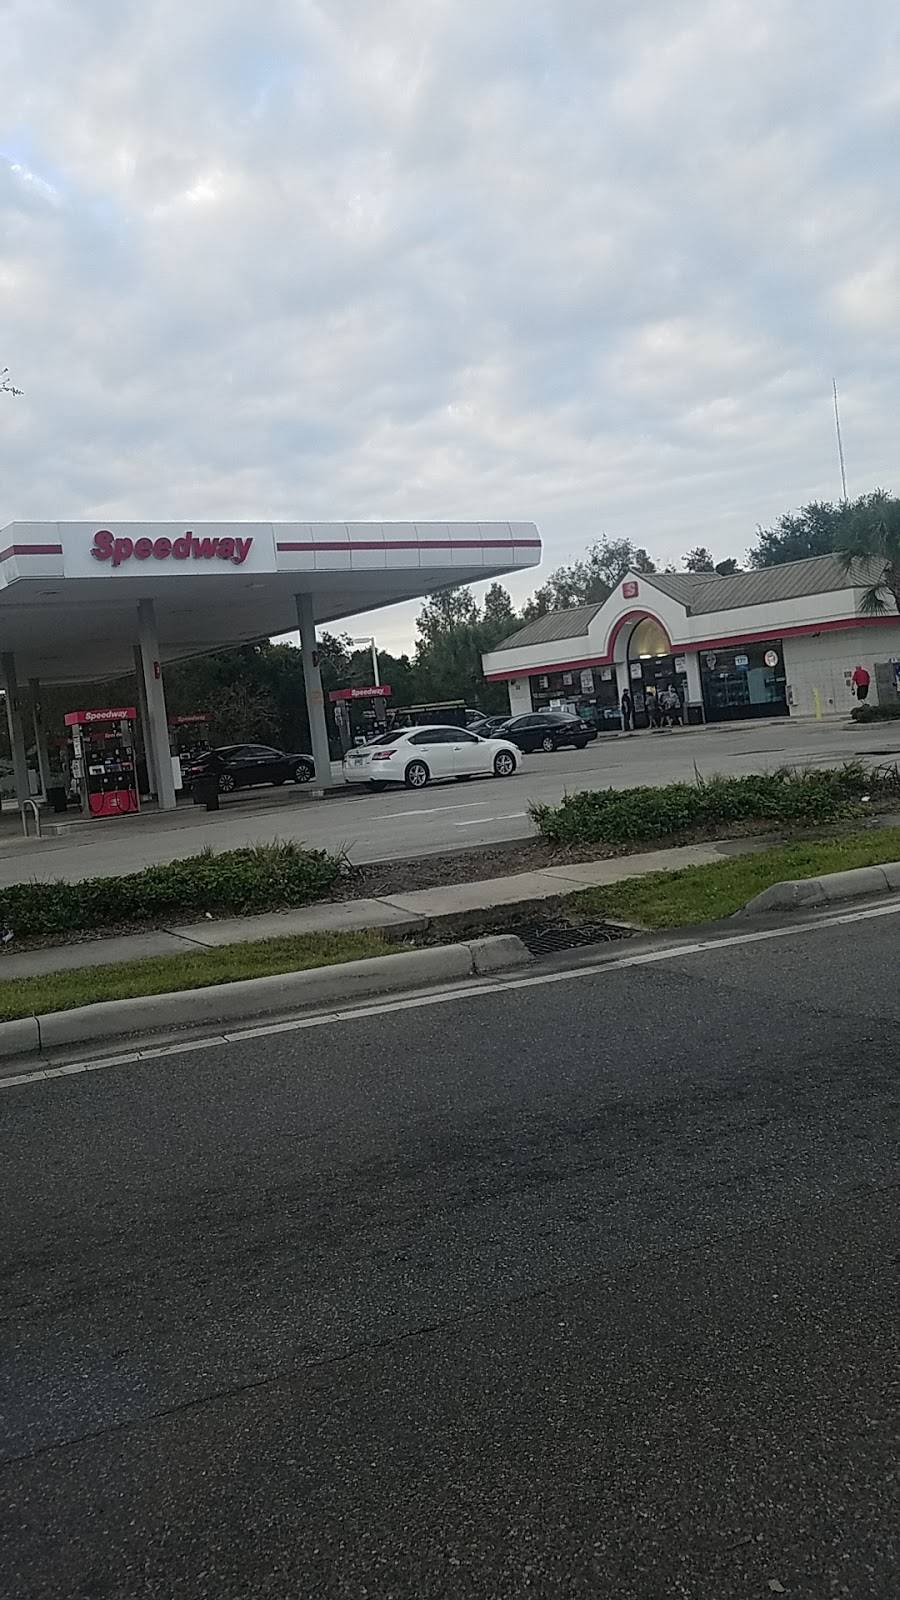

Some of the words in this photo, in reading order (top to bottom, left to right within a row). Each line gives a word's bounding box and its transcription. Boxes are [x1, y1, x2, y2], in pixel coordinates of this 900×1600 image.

[90, 530, 254, 567] Speedway
[351, 687, 385, 698] Speedway
[85, 710, 128, 721] Speedway
[177, 714, 206, 723] Speedway
